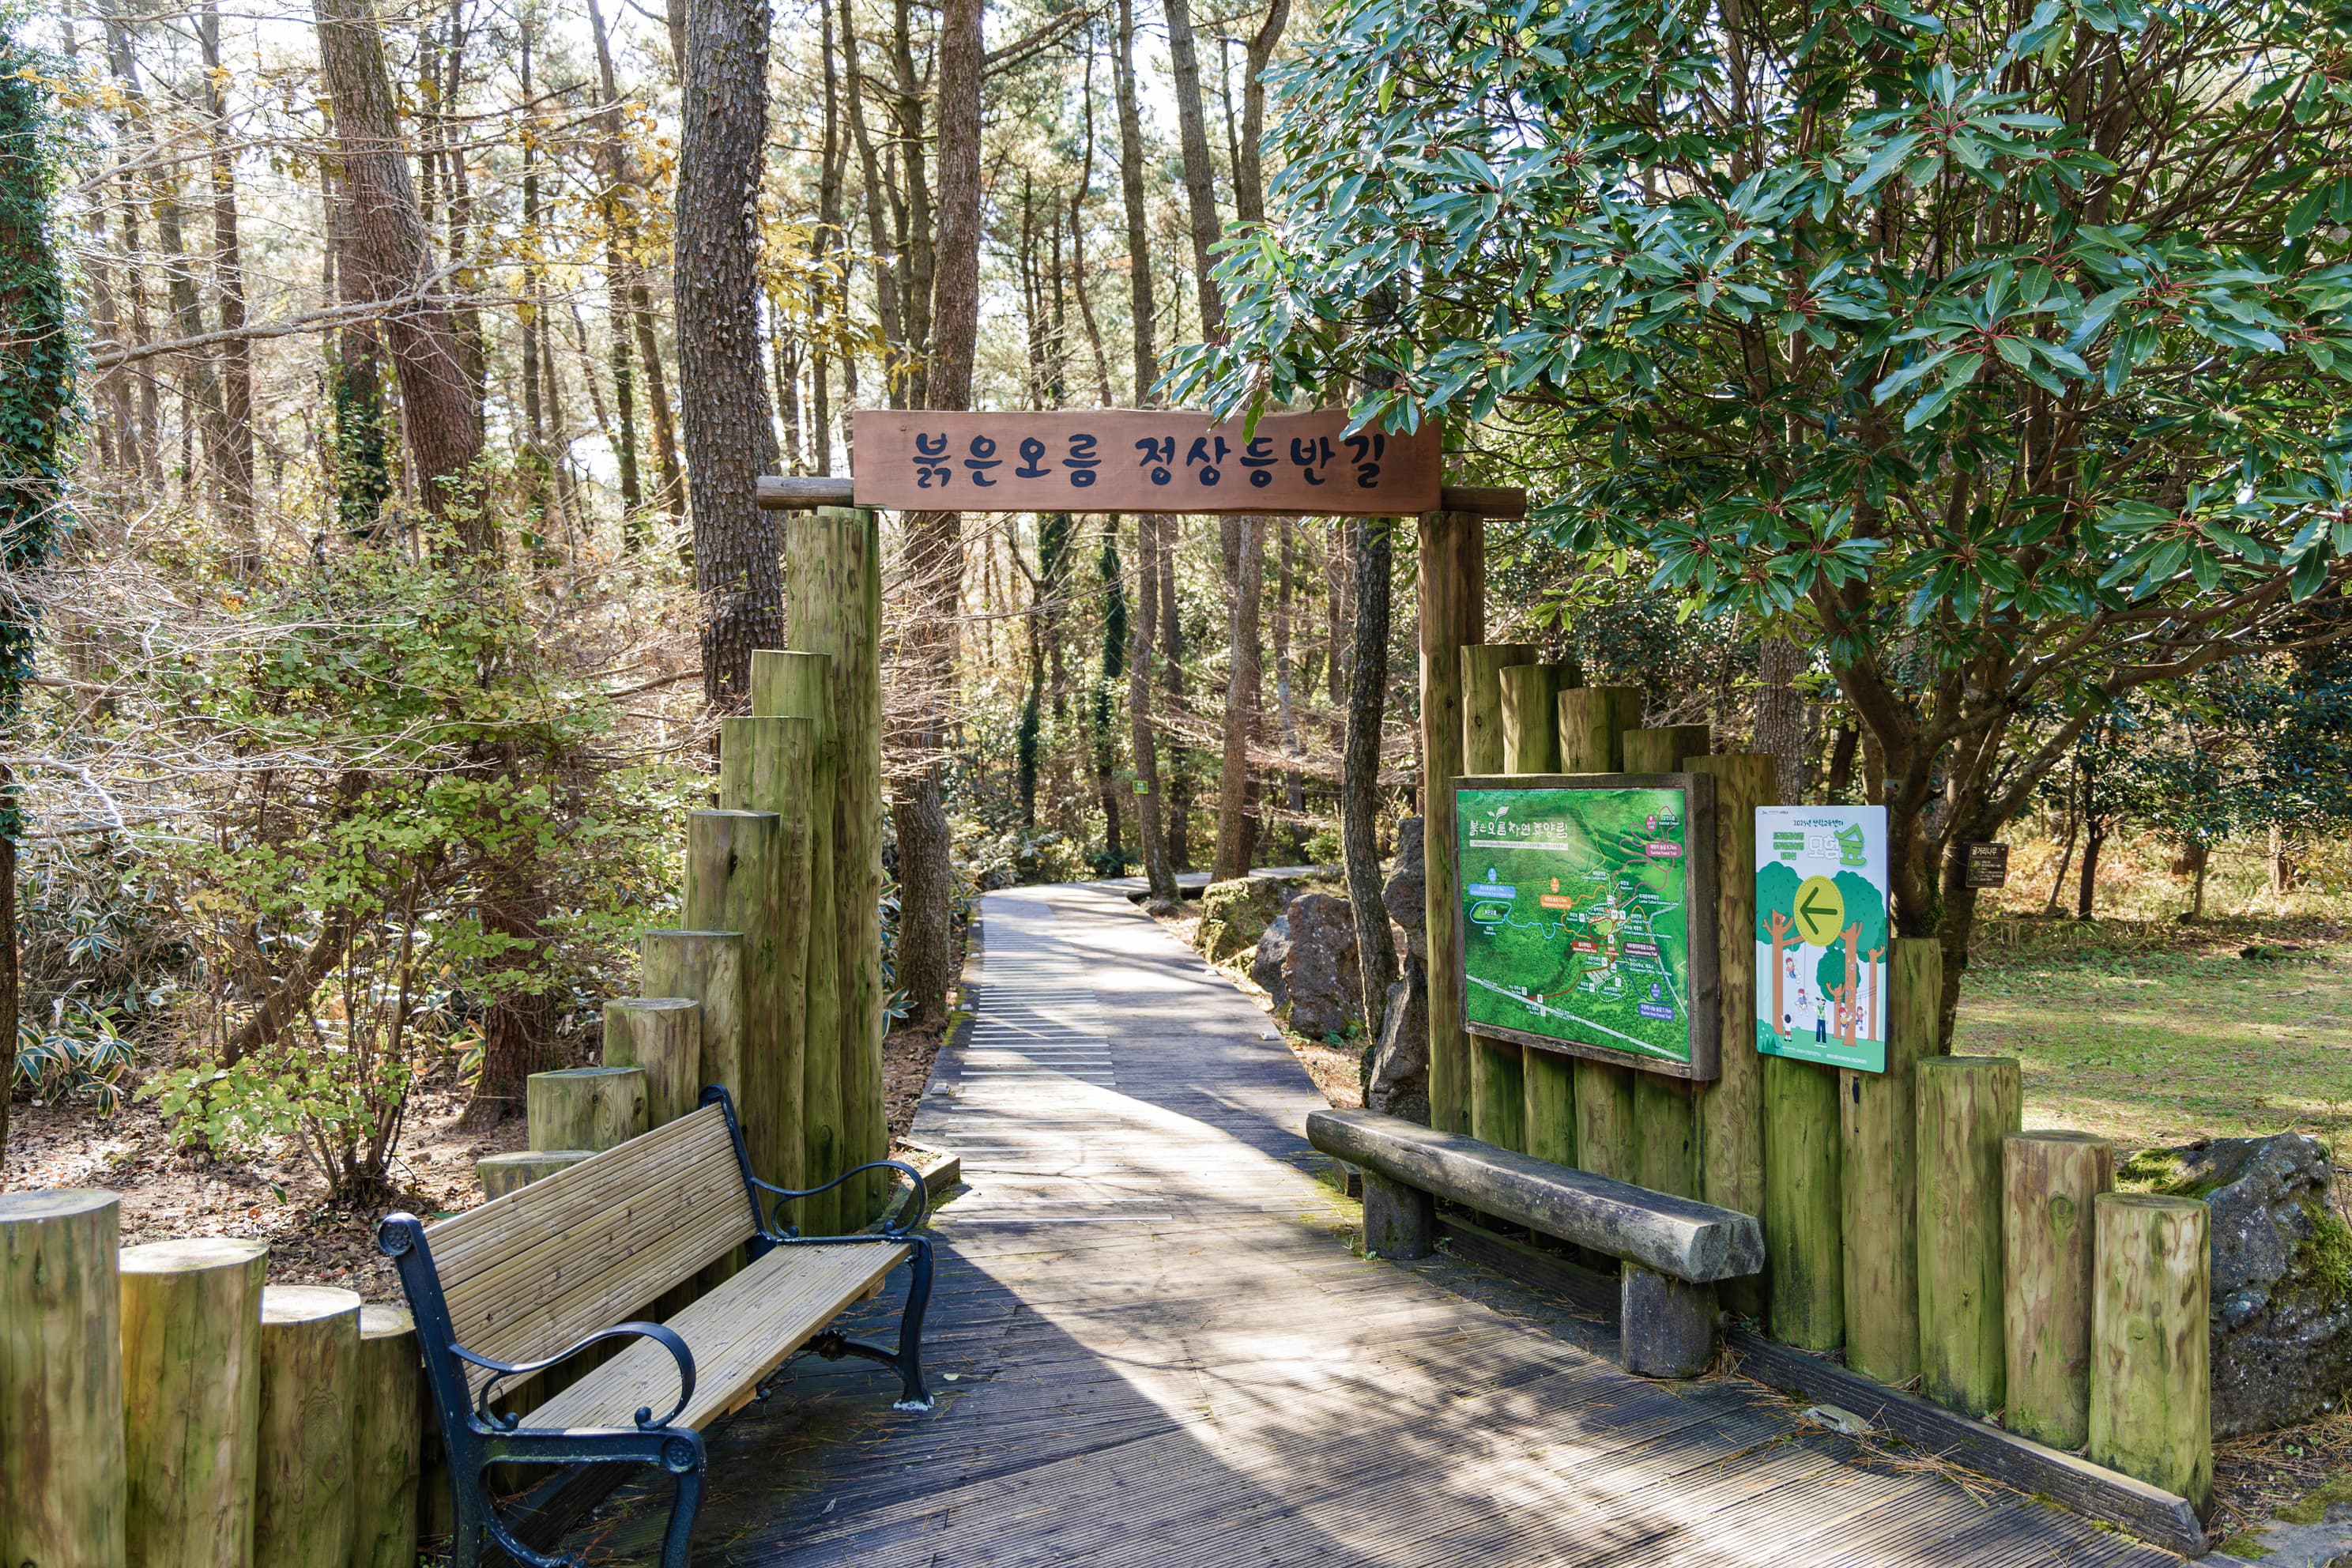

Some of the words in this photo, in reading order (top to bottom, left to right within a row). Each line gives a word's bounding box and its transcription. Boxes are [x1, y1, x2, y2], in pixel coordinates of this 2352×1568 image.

[912, 432, 1101, 488] 붉은오름
[1134, 433, 1385, 488] 정상등반길
[1469, 820, 1506, 836] 붉은오름
[1972, 846, 1997, 856] 굴거리나무
